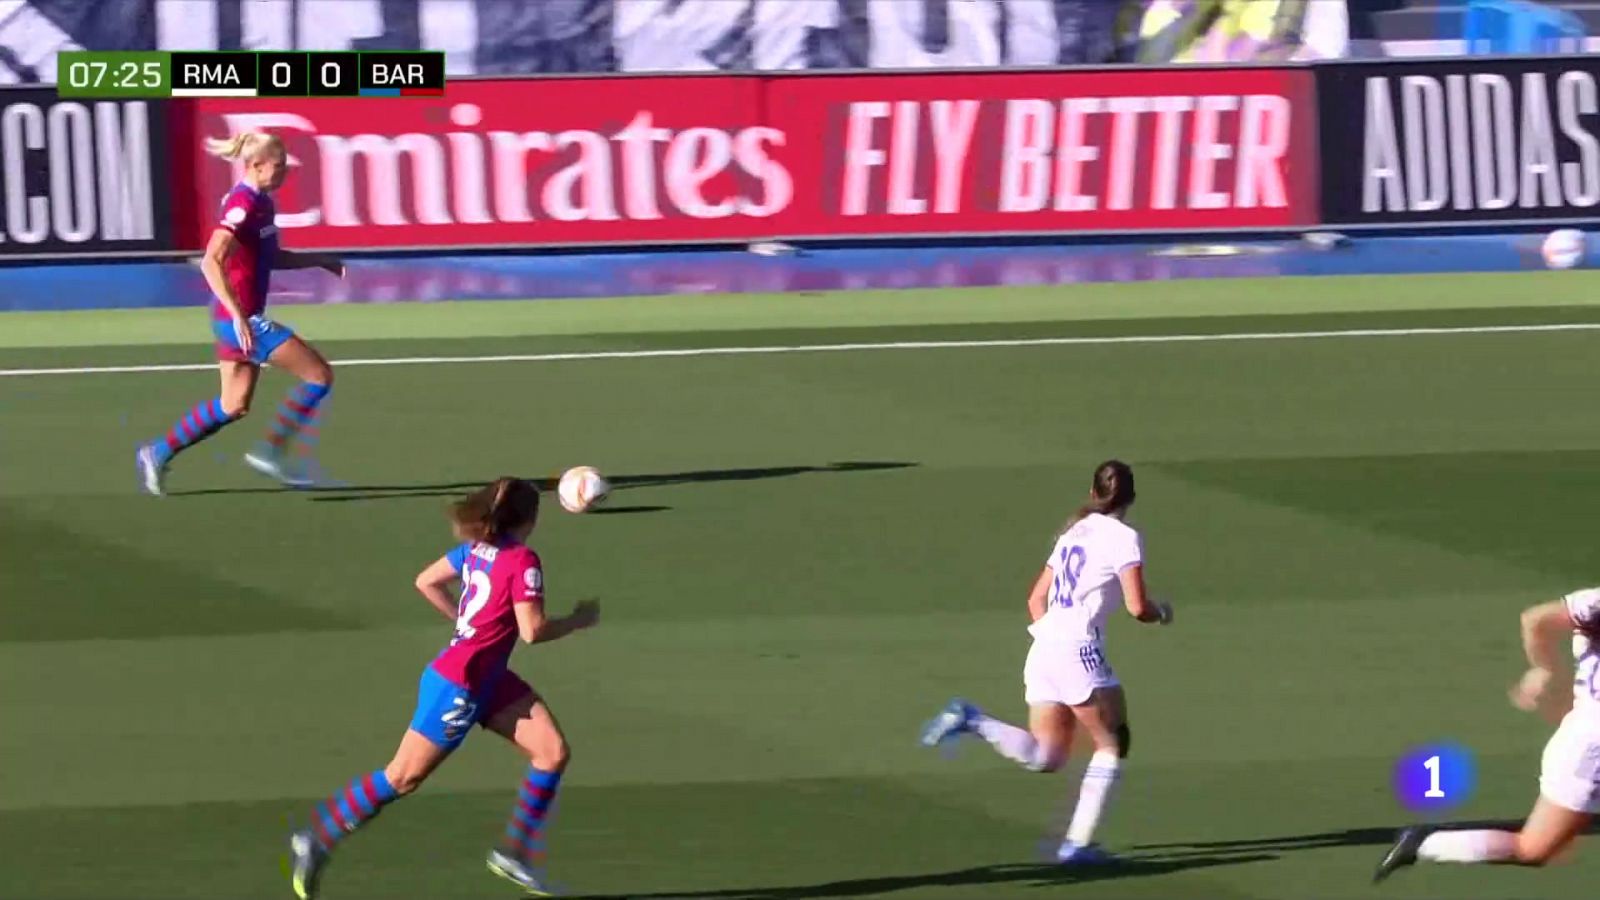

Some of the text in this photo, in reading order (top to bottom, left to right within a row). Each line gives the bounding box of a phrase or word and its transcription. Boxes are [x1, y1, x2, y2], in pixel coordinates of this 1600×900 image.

[222, 95, 1291, 228] Emirates FLY BETTER
[1362, 70, 1600, 212] ADIDAS
